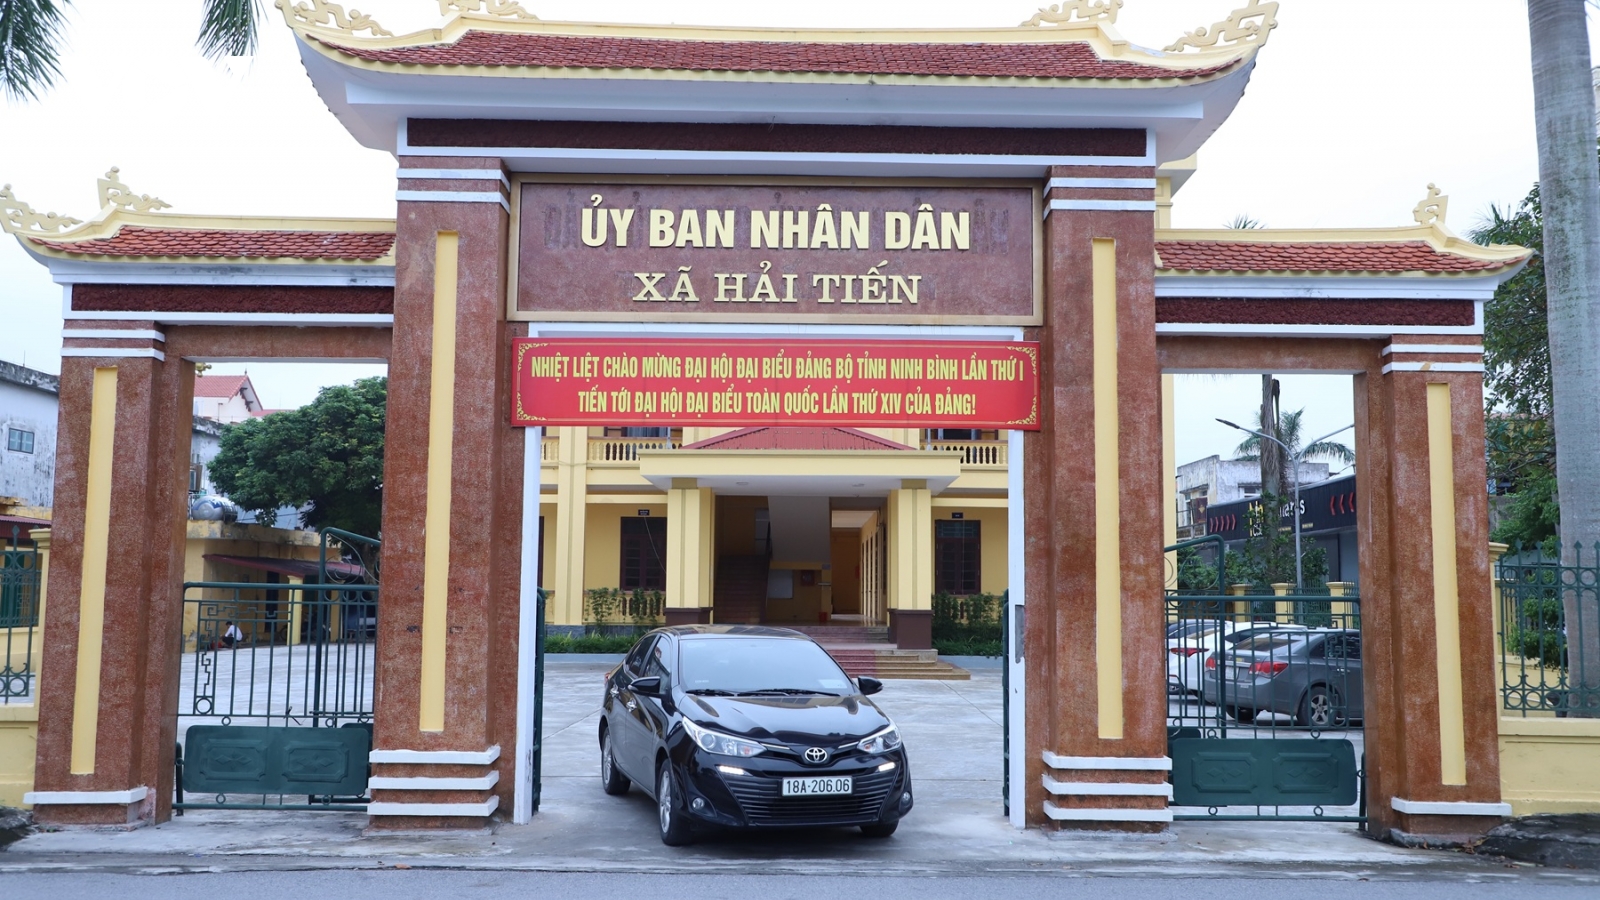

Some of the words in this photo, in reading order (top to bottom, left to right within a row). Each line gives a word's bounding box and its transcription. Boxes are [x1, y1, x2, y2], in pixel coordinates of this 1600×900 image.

[580, 194, 634, 247] ỦY
[649, 208, 735, 249] BAN
[750, 203, 870, 250] NHÂN
[885, 203, 971, 250] DÂN
[632, 265, 699, 302] XÃ
[714, 260, 797, 303] HẢI
[813, 259, 922, 304] TIẾN
[531, 352, 570, 383] NHIỆT
[573, 352, 599, 383] LIỆT
[602, 352, 639, 379] CHÀO
[642, 352, 682, 379] MỪNG
[685, 357, 708, 383] ĐẠI
[710, 353, 733, 383] HỘI
[736, 357, 759, 384] ĐẠI
[762, 348, 793, 379] BIỂU
[795, 351, 832, 380] ĐẢNG
[834, 352, 854, 384] BỘ
[856, 350, 887, 380] TỈNH
[890, 358, 923, 381] NINH
[926, 354, 959, 381] BÌNH
[961, 351, 987, 381] LẦN
[990, 356, 1018, 382] THỨ
[1018, 360, 1025, 381] I
[577, 384, 608, 413] TIẾN
[610, 386, 632, 413] TỚI
[634, 391, 657, 418] ĐẠI
[660, 387, 683, 418] HỘI
[685, 391, 709, 418] ĐẠI
[712, 383, 743, 414] BIỂU
[745, 386, 781, 414] TOÀN
[783, 384, 819, 416] QUỐC
[822, 384, 849, 414] LẦN
[851, 388, 879, 415] THỨ
[880, 392, 902, 415] XIV
[905, 386, 933, 415] CỦA
[935, 386, 977, 416] ĐẢNG!
